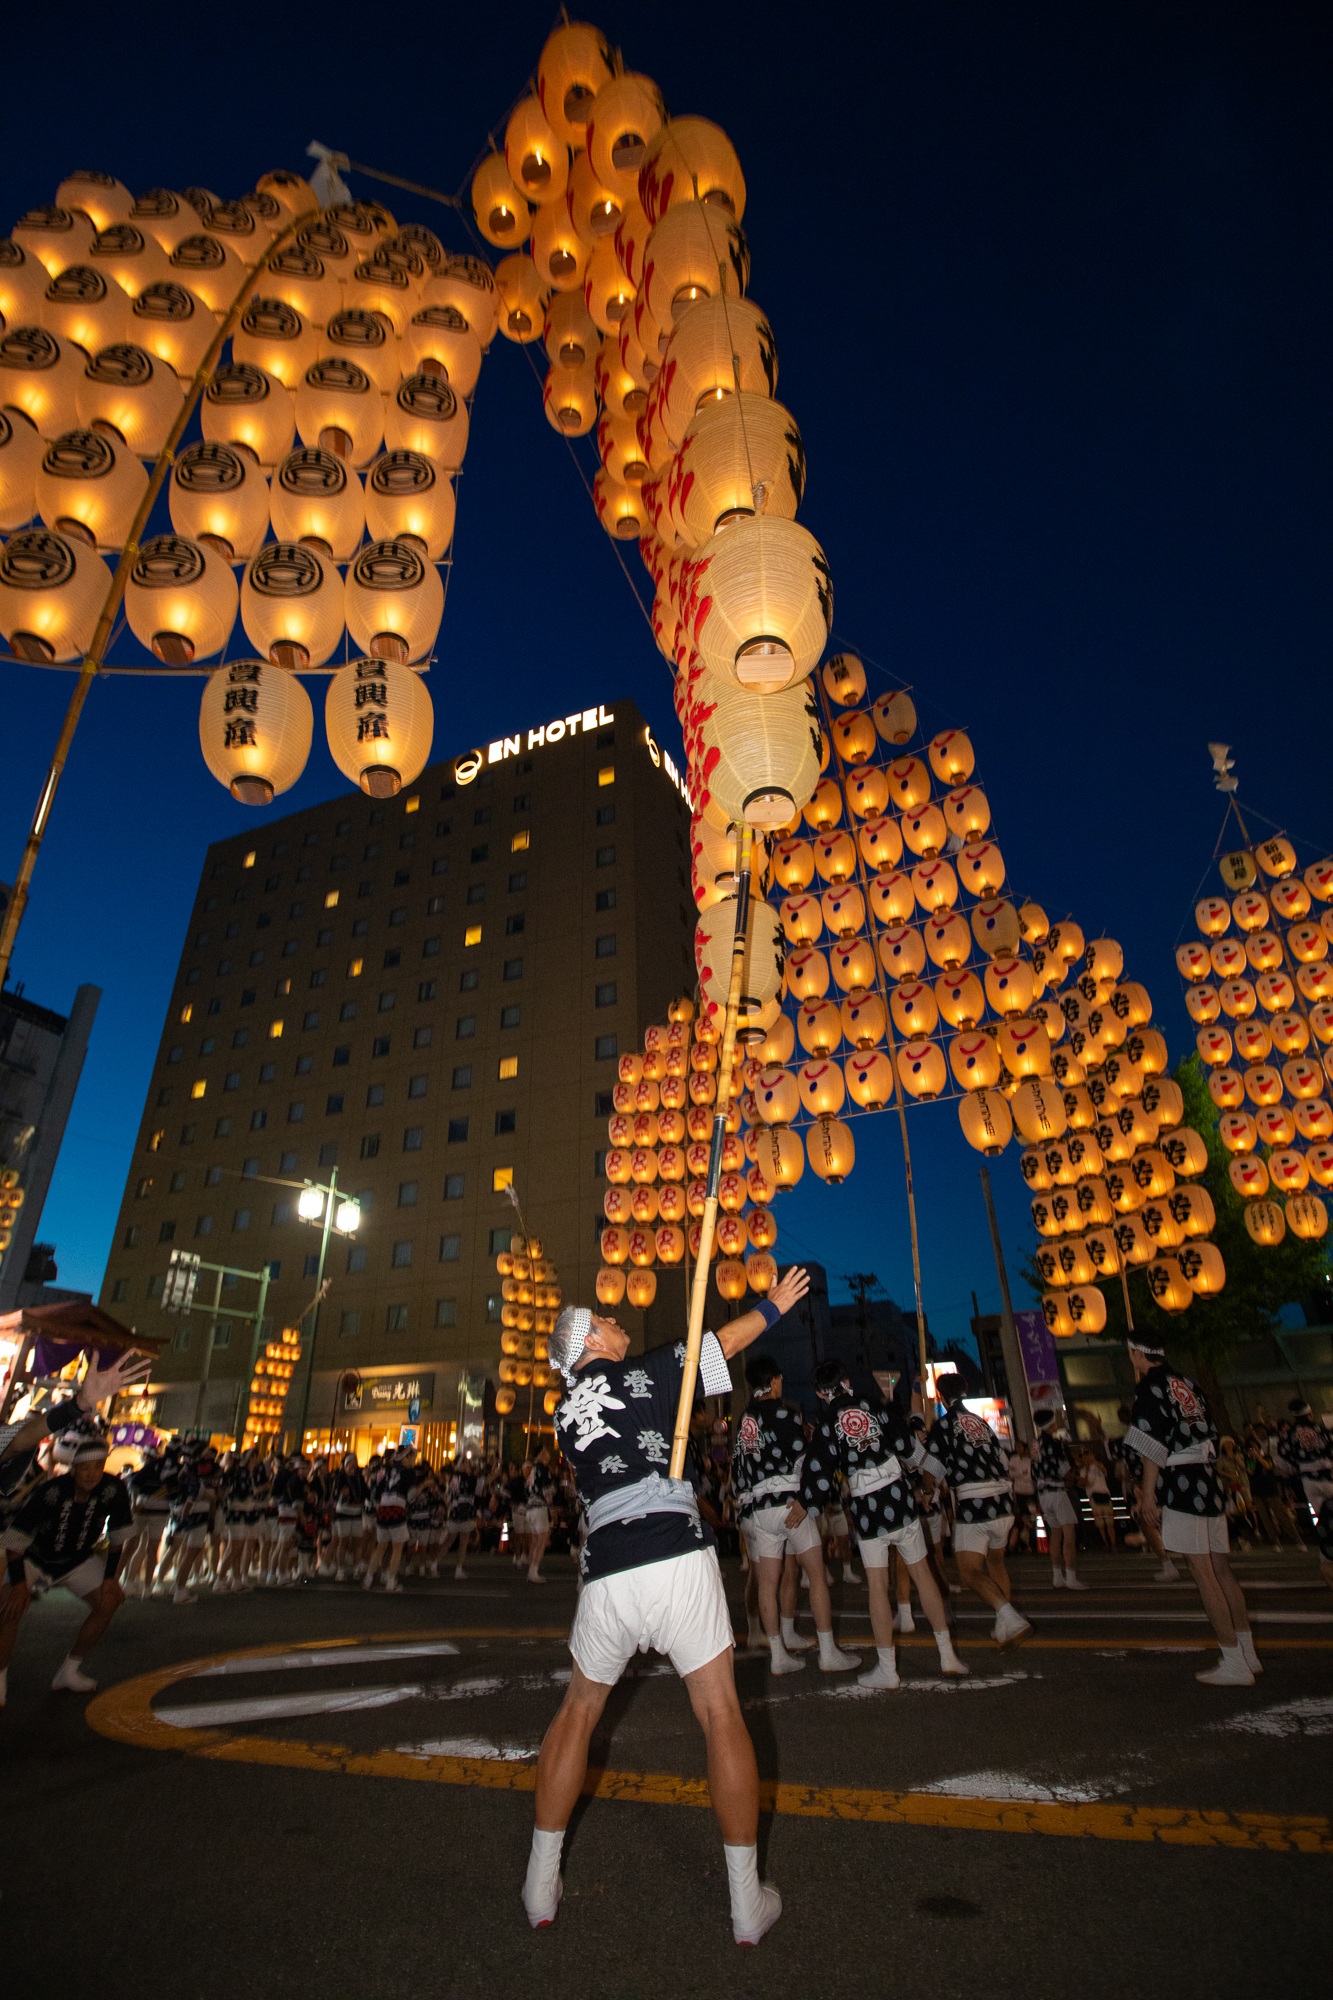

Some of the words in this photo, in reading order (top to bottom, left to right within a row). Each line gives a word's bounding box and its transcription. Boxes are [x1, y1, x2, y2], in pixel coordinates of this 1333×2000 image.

[488, 733, 521, 764] EN
[528, 705, 615, 751] HOTEL
[623, 1369, 655, 1399] 登
[559, 1374, 627, 1452] 登
[637, 1430, 671, 1465] 登
